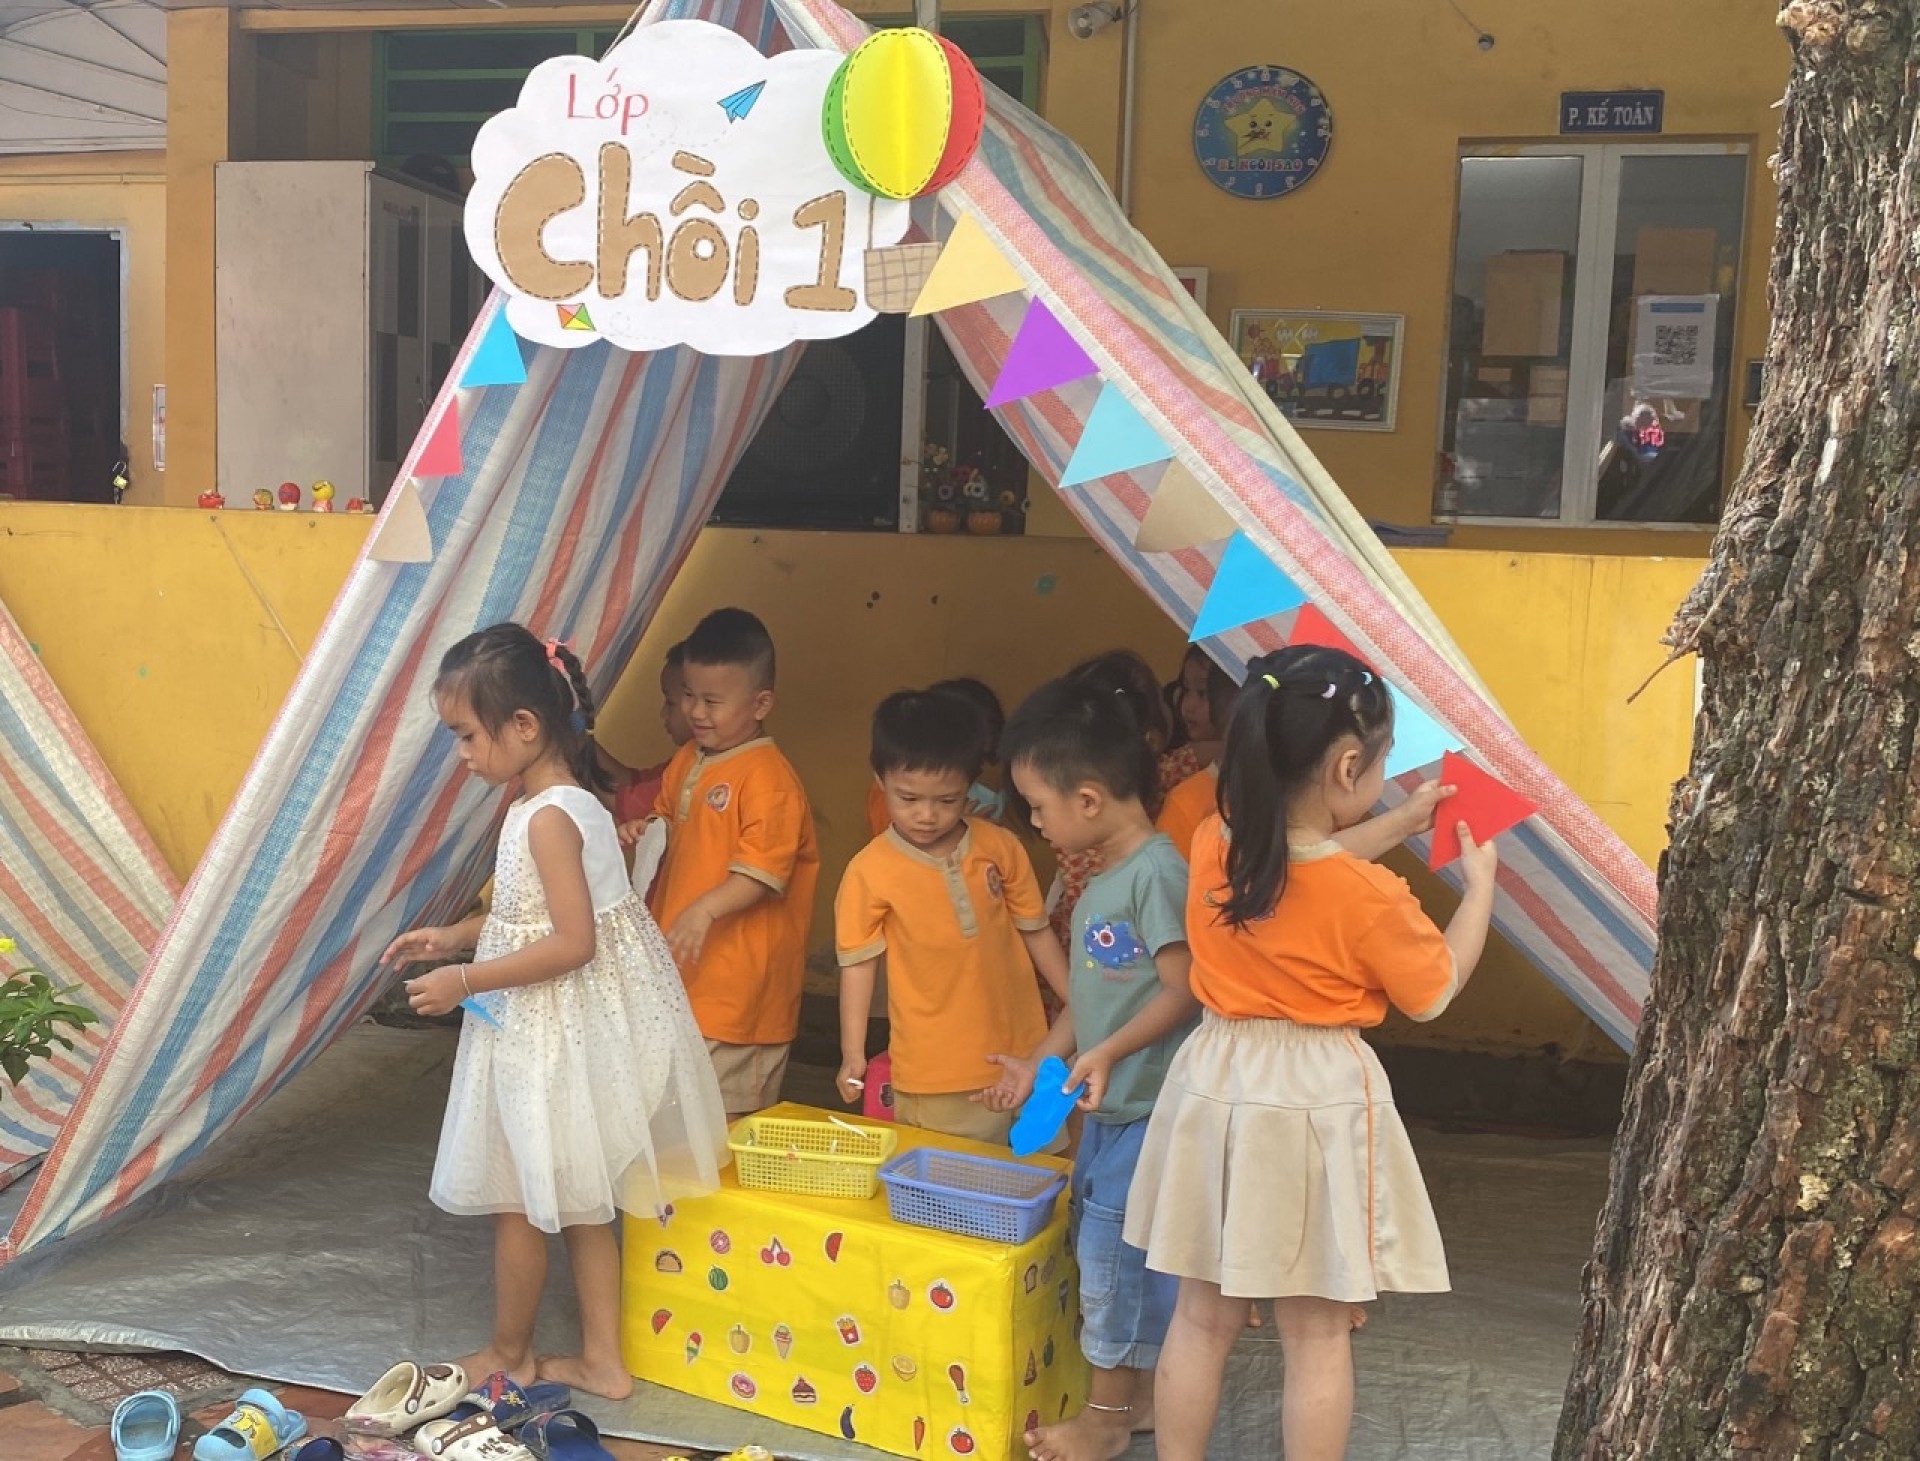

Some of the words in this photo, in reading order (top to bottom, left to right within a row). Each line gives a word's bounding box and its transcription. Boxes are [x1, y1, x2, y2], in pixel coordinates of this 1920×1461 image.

[567, 68, 648, 134] Lớp
[1567, 107, 1582, 127] P.
[1586, 98, 1610, 127] KẾ
[1613, 101, 1655, 126] TOÁN
[494, 141, 759, 307] Chồi
[784, 190, 858, 313] 1
